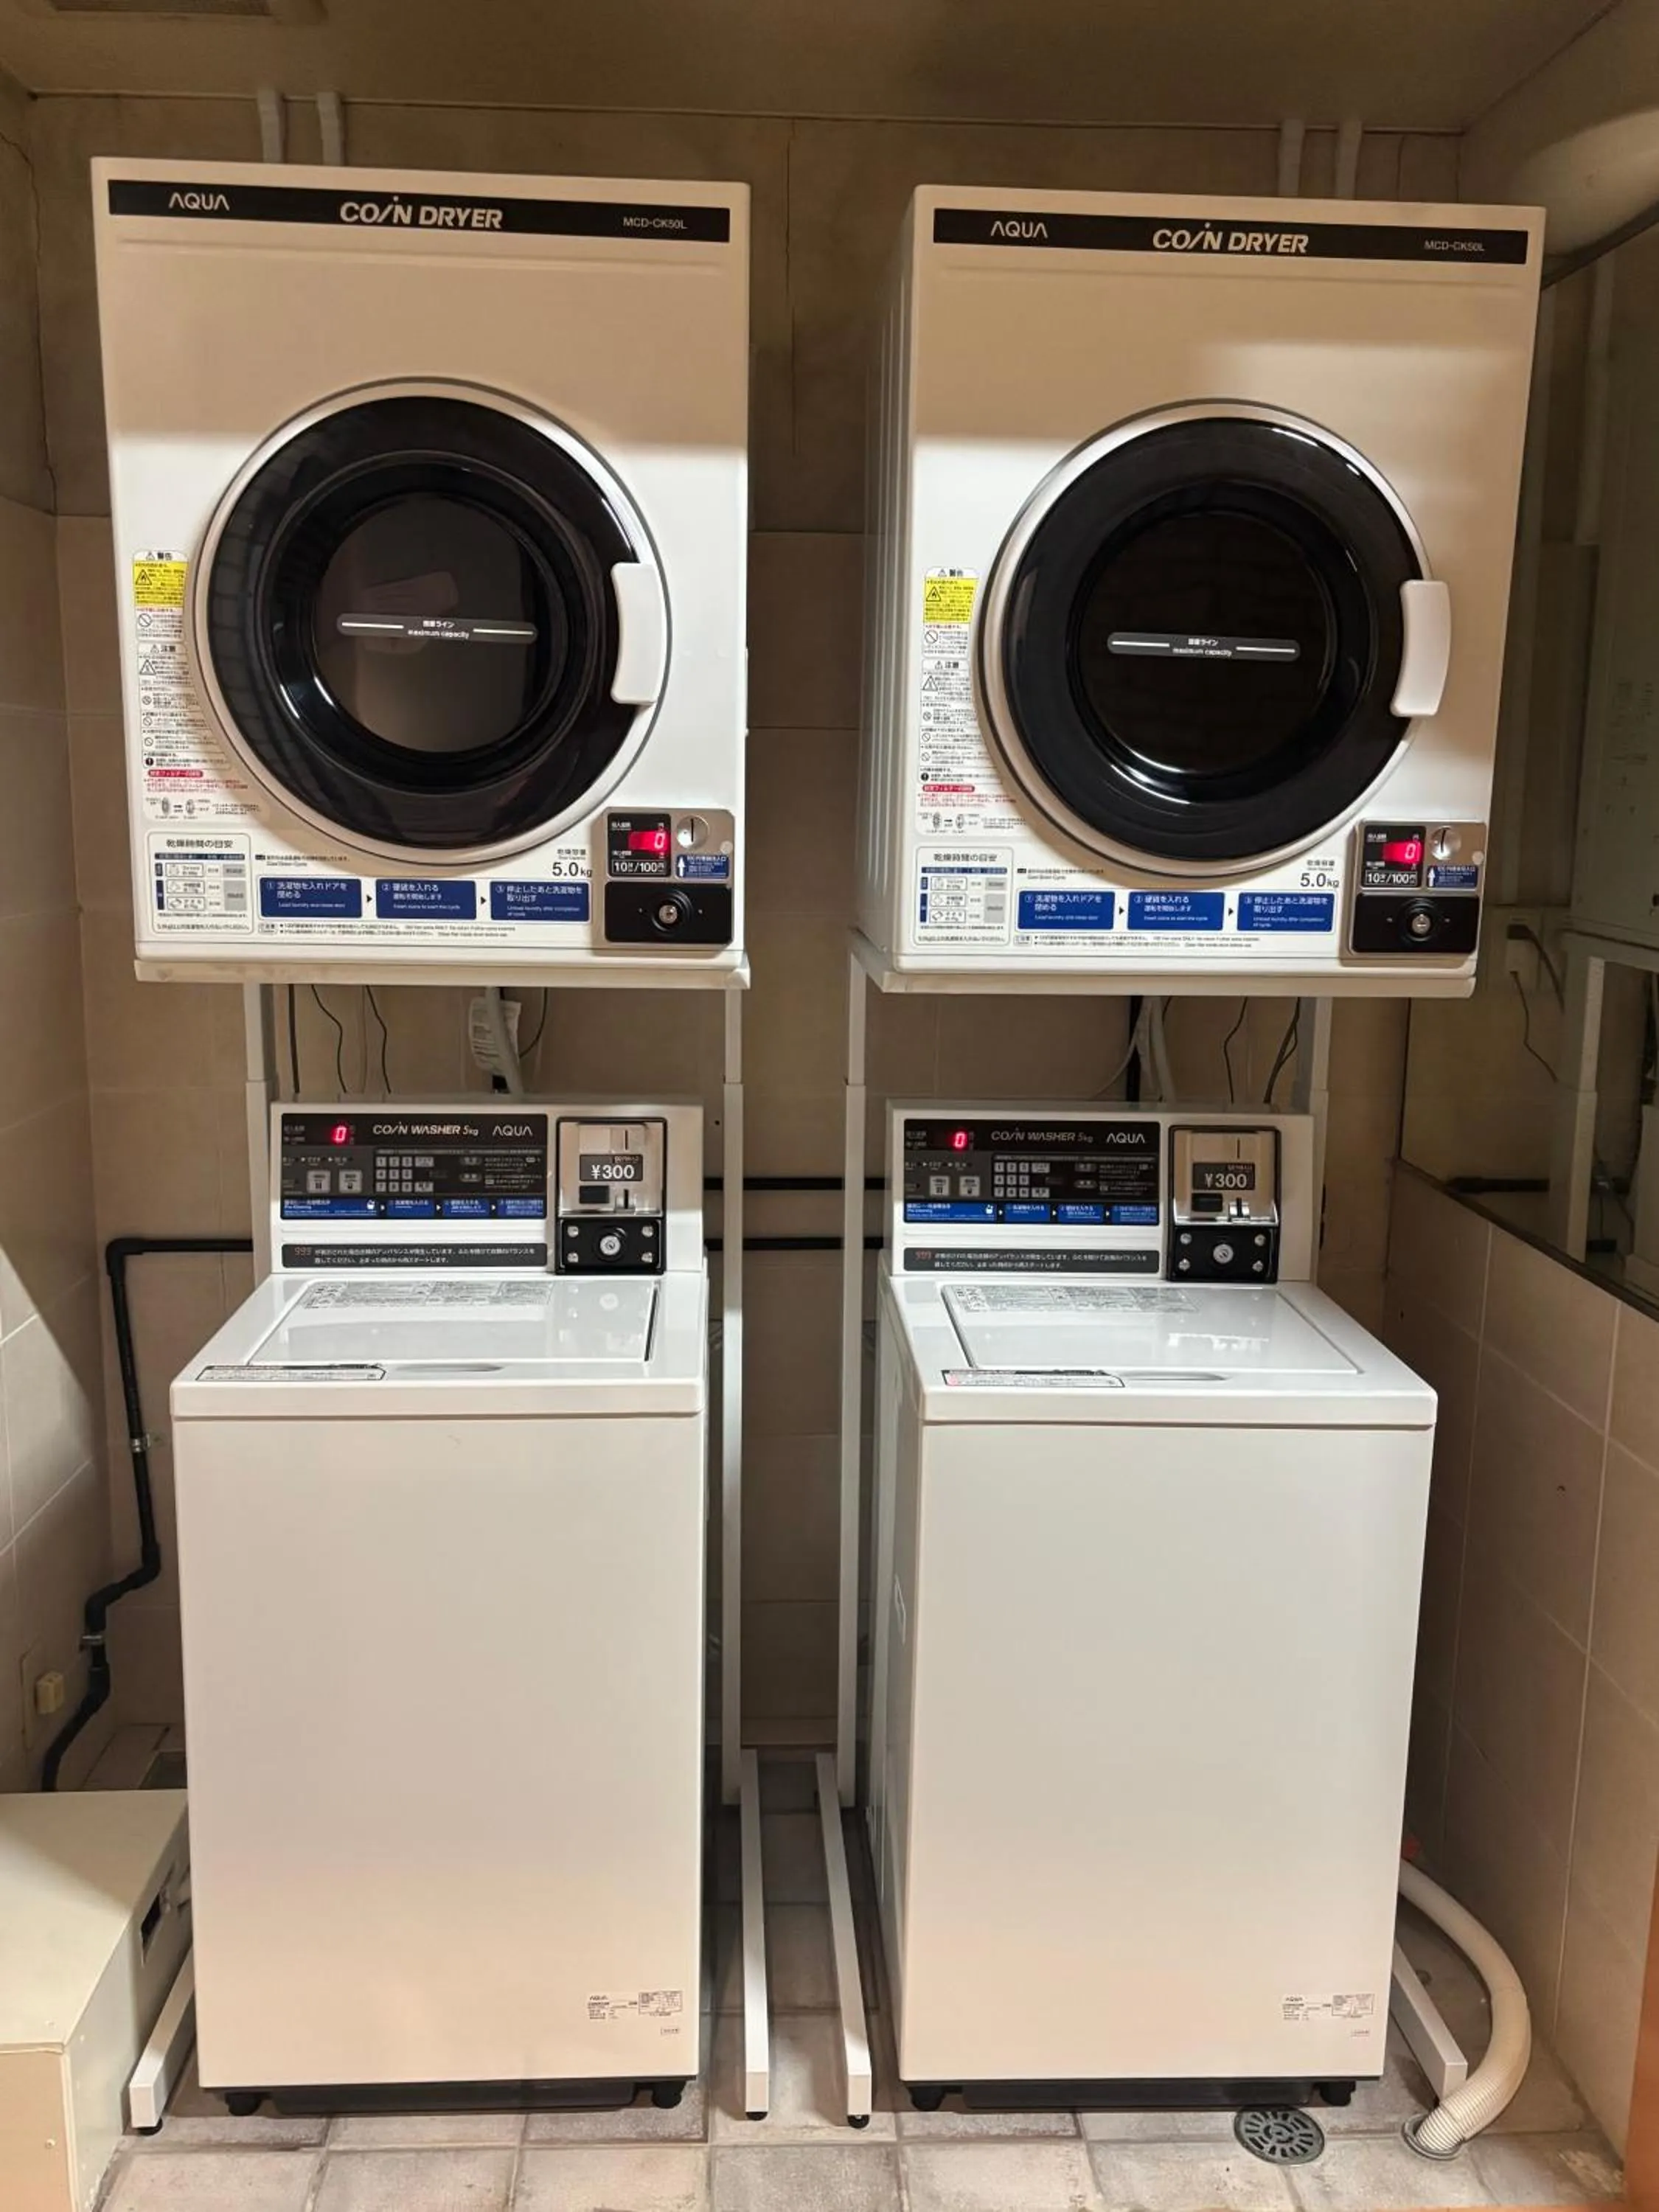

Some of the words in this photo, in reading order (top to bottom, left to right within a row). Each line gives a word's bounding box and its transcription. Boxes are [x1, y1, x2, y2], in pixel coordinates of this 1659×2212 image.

[169, 192, 229, 212] AQUA
[419, 204, 502, 229] DRYER
[622, 215, 687, 230] MCD-CK50L
[991, 220, 1047, 239] AQUA
[1228, 230, 1309, 254] DRYER
[441, 631, 470, 639] capacity
[1204, 649, 1232, 657] capacity
[166, 838, 234, 849] 乾燥時間の目安
[654, 832, 666, 849] 0
[1405, 843, 1416, 860] 0
[552, 861, 593, 878] 5.0kg
[276, 881, 348, 891] 洗濯物を入れドアを
[1300, 873, 1340, 888] 5.0kg
[507, 885, 582, 894] 停止したあと洗濯物を
[1034, 894, 1102, 904] 洗濯物を入れドアを
[1254, 896, 1328, 905] 停止したあと洗濯物を
[334, 1126, 347, 1142] 0
[410, 1124, 462, 1136] WASHER
[492, 1125, 534, 1137] AQUA
[1027, 1131, 1076, 1142] WASHER
[954, 1132, 967, 1148] 0
[1106, 1132, 1146, 1144] AQUA
[591, 1164, 635, 1180] ¥300
[1204, 1173, 1247, 1188] ¥300
